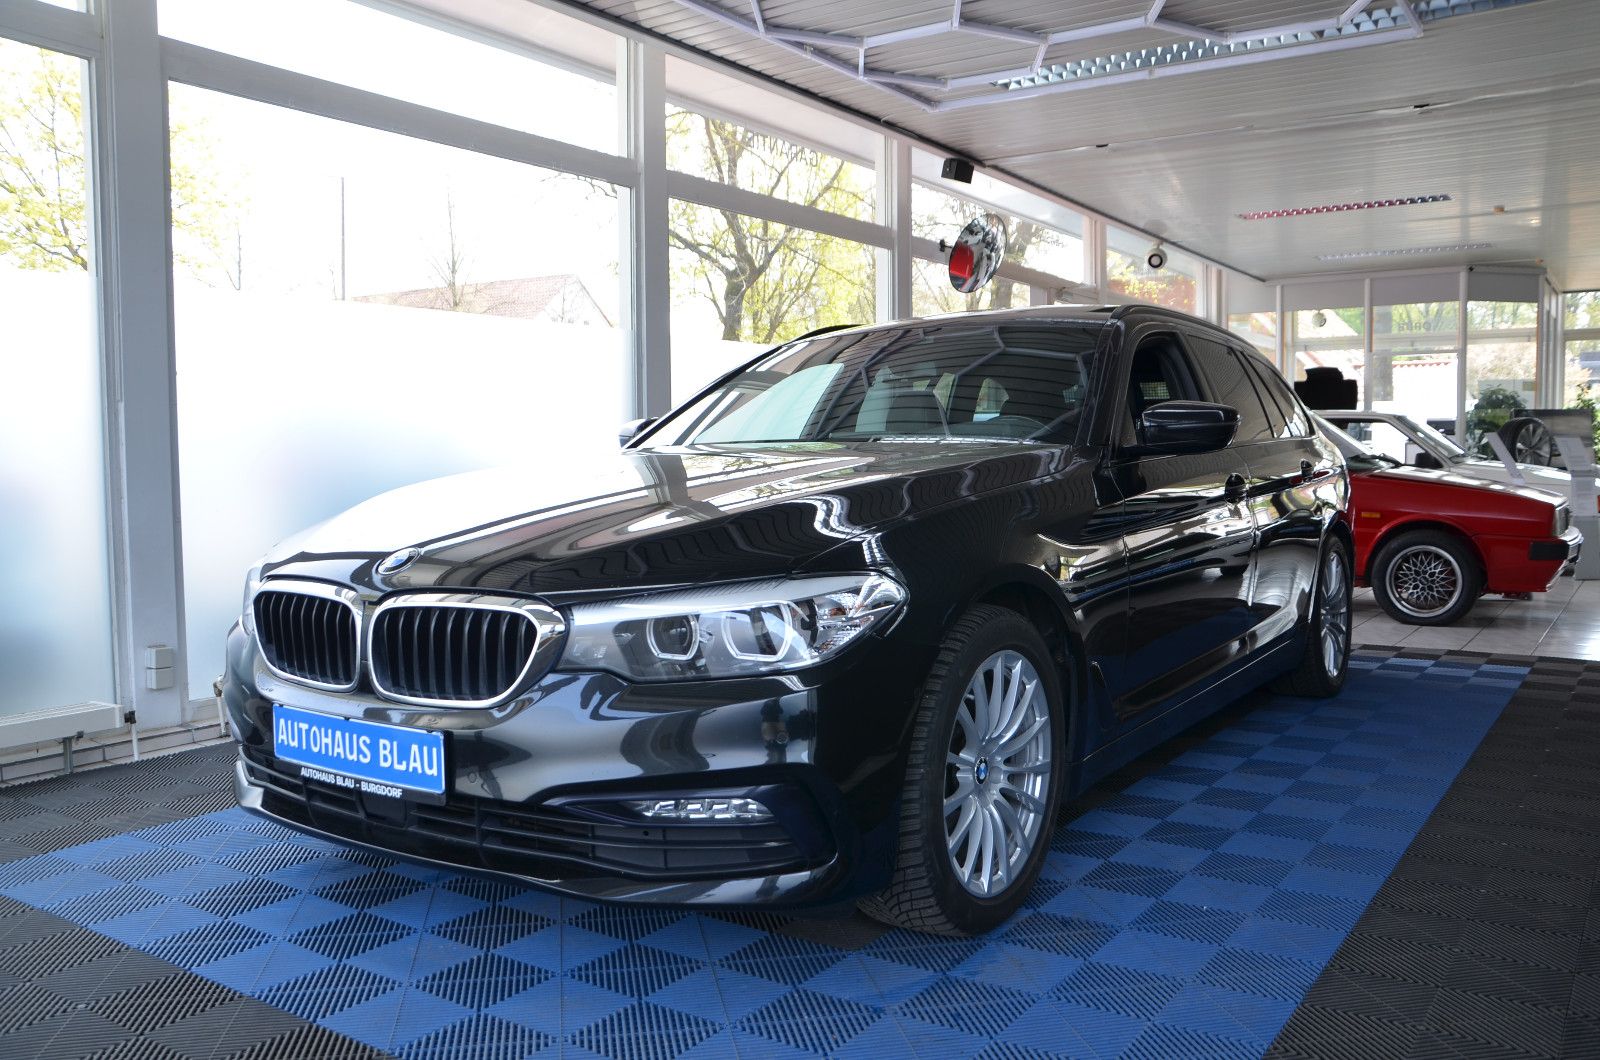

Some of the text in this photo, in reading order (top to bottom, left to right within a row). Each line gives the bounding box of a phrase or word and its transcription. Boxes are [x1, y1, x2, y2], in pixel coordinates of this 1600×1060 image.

[278, 718, 438, 777] AUTOHAUS BLAU
[300, 767, 336, 784] AUTOHAUS
[336, 774, 355, 789] BLAU
[361, 780, 403, 799] BURGDORF
